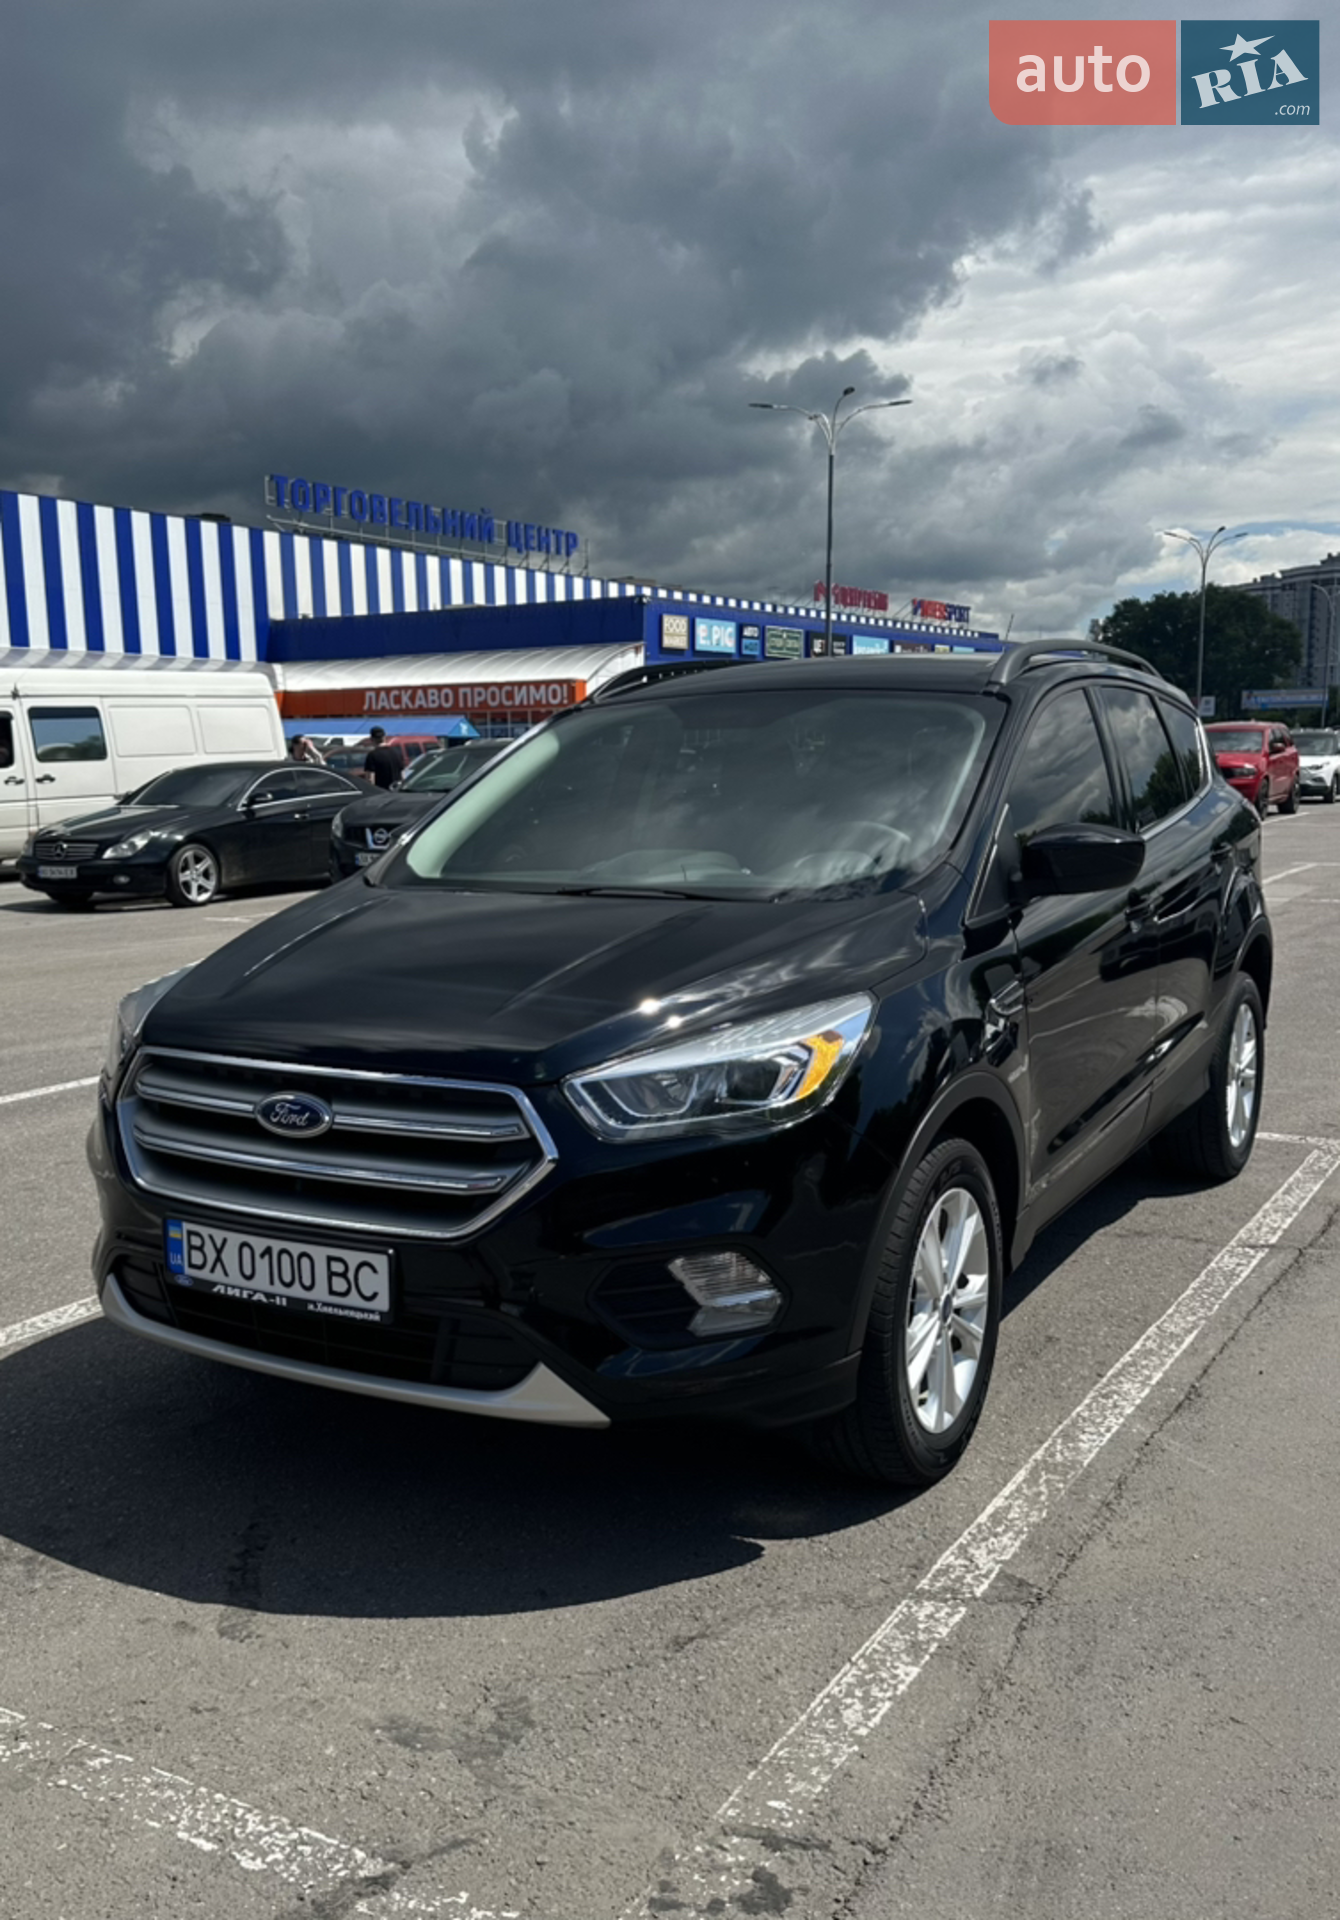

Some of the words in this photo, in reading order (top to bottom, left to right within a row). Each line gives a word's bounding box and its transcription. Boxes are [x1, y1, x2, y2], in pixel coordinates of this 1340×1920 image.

[271, 474, 495, 544] ТОРГОВЕЛЬНИЙ
[507, 520, 578, 557] ЦЕНТР
[363, 685, 454, 711] ЛАСКАВО
[458, 683, 568, 708] ПРОСИМО!
[269, 1102, 310, 1127] Ford
[186, 1229, 229, 1278] BX
[238, 1241, 316, 1292] 0100
[326, 1255, 379, 1302] BC
